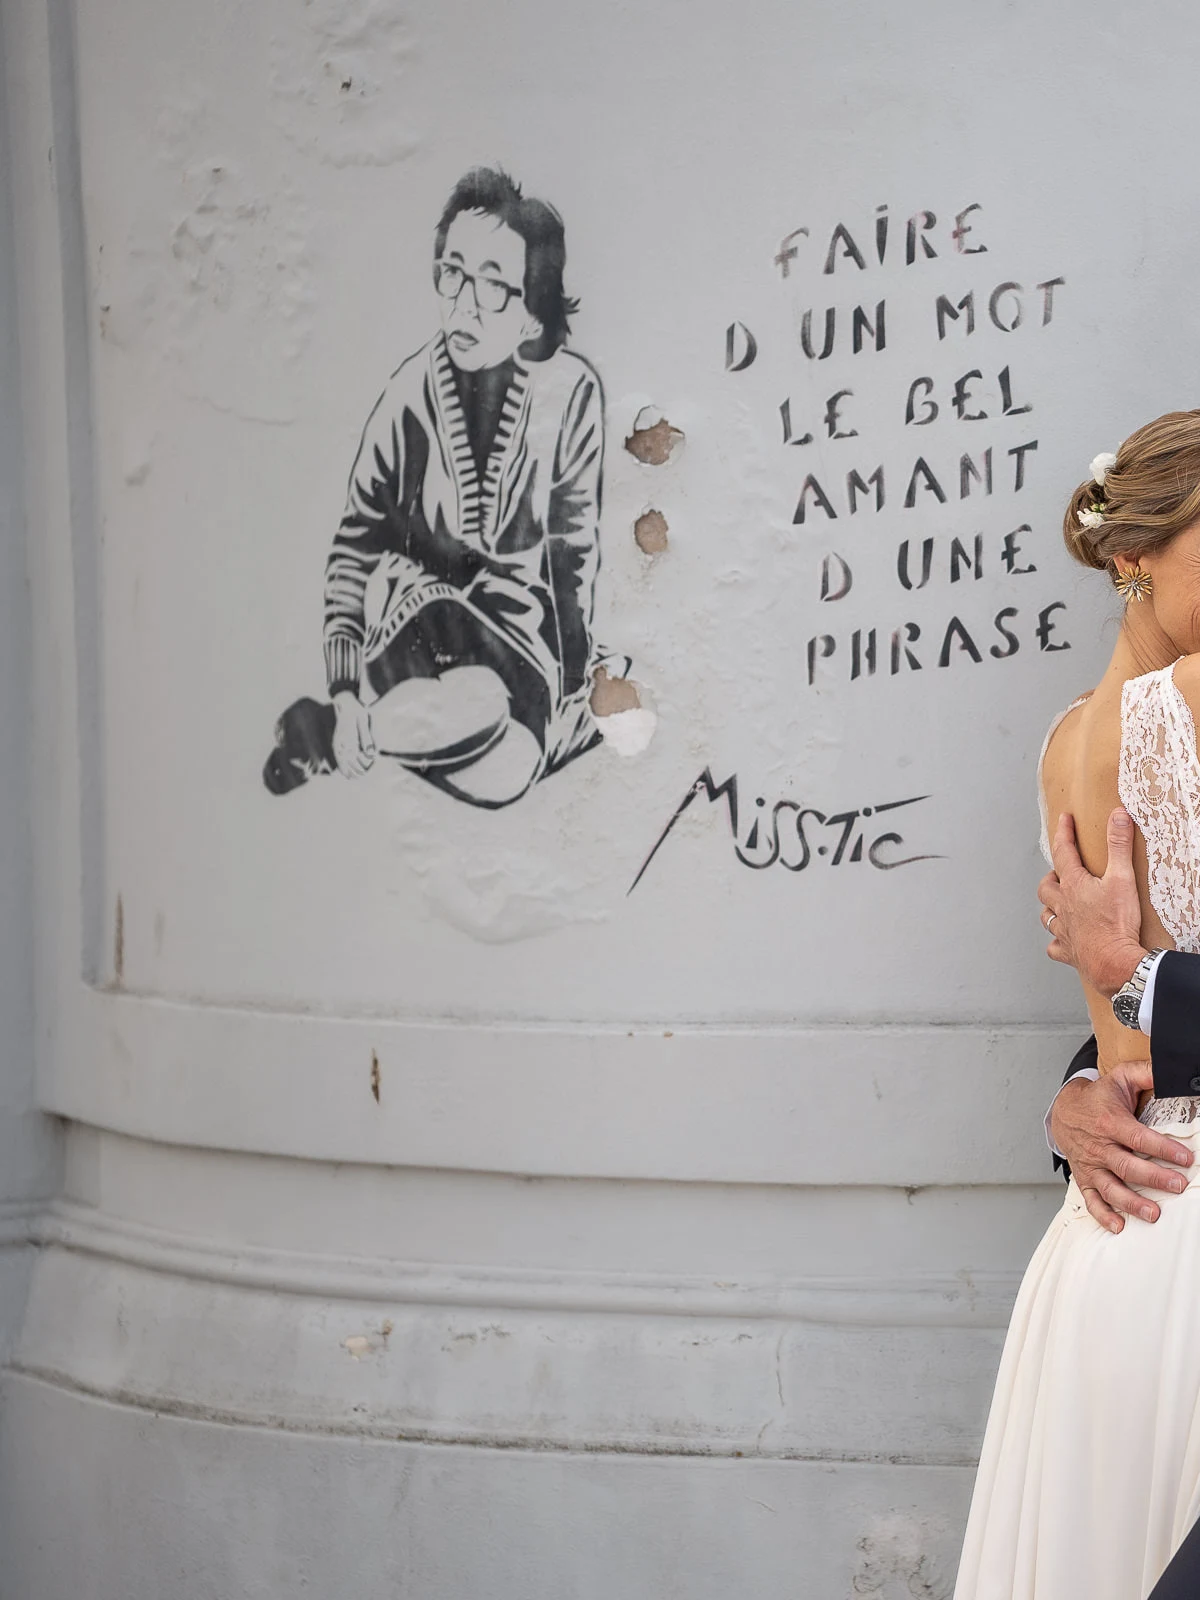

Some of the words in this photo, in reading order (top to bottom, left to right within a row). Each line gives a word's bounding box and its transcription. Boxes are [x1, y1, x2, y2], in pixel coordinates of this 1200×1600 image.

[725, 321, 758, 372] D
[801, 299, 886, 360] UN
[936, 276, 1065, 341] MOT
[779, 388, 858, 446] LE
[905, 365, 1033, 426] BEL
[792, 439, 1038, 525] AMANT
[820, 552, 853, 602] D
[897, 524, 1037, 591] UNE
[807, 601, 1072, 686] PHRASE
